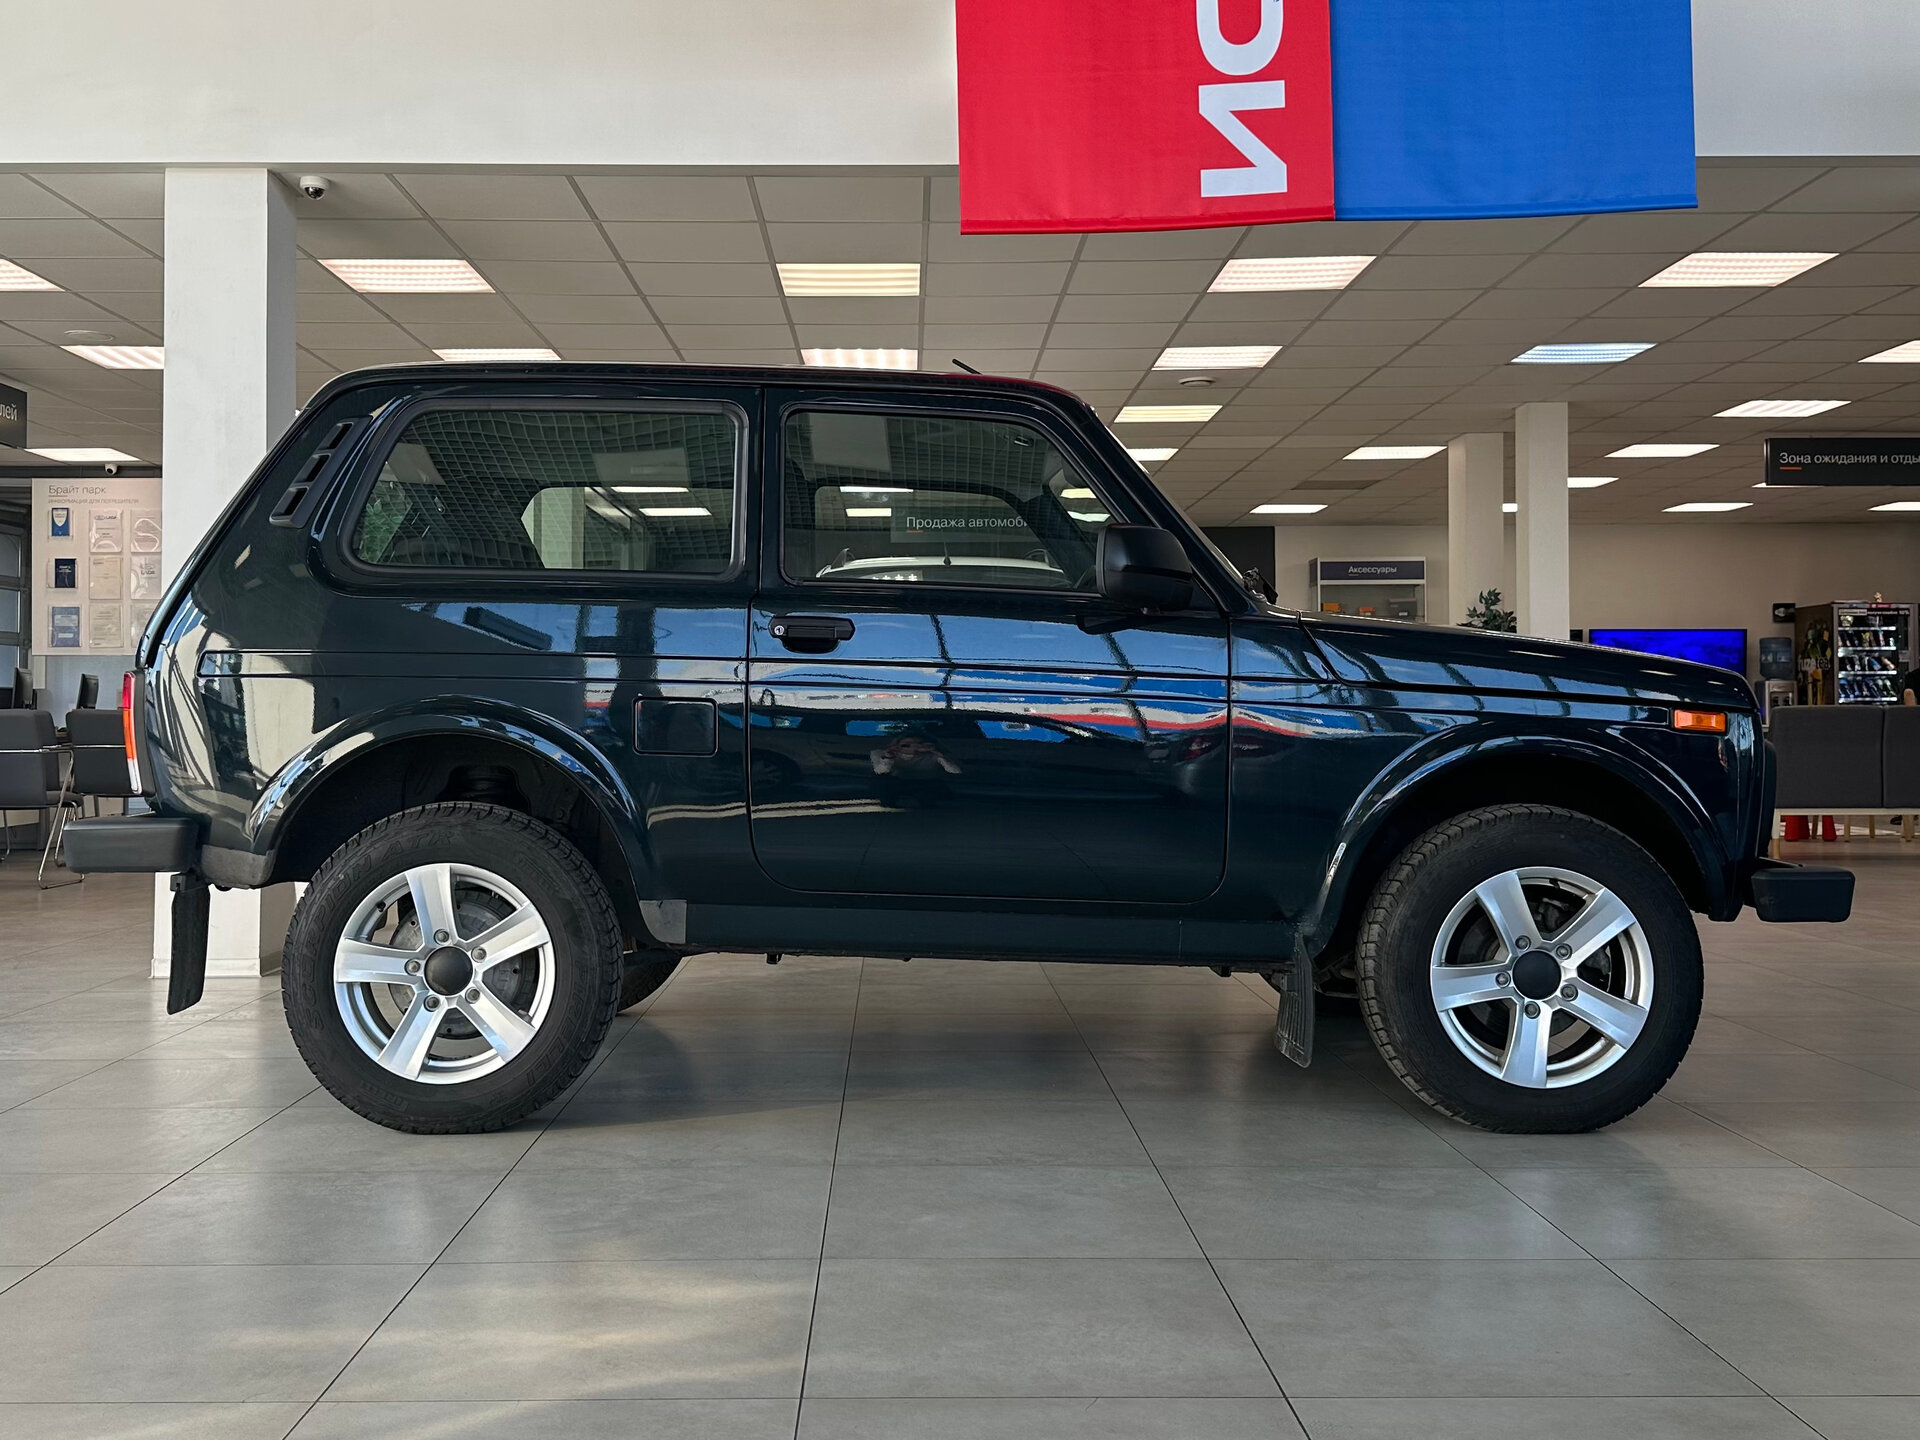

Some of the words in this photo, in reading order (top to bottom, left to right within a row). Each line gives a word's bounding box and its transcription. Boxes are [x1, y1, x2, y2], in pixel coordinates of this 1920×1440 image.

[1779, 452, 1812, 464] Зона
[1814, 454, 1877, 465] ожидания
[1880, 455, 1888, 463] и
[48, 485, 79, 495] Брайт
[82, 487, 107, 495] парк
[906, 516, 965, 529] Продажа
[1348, 565, 1397, 574] Аксессуары
